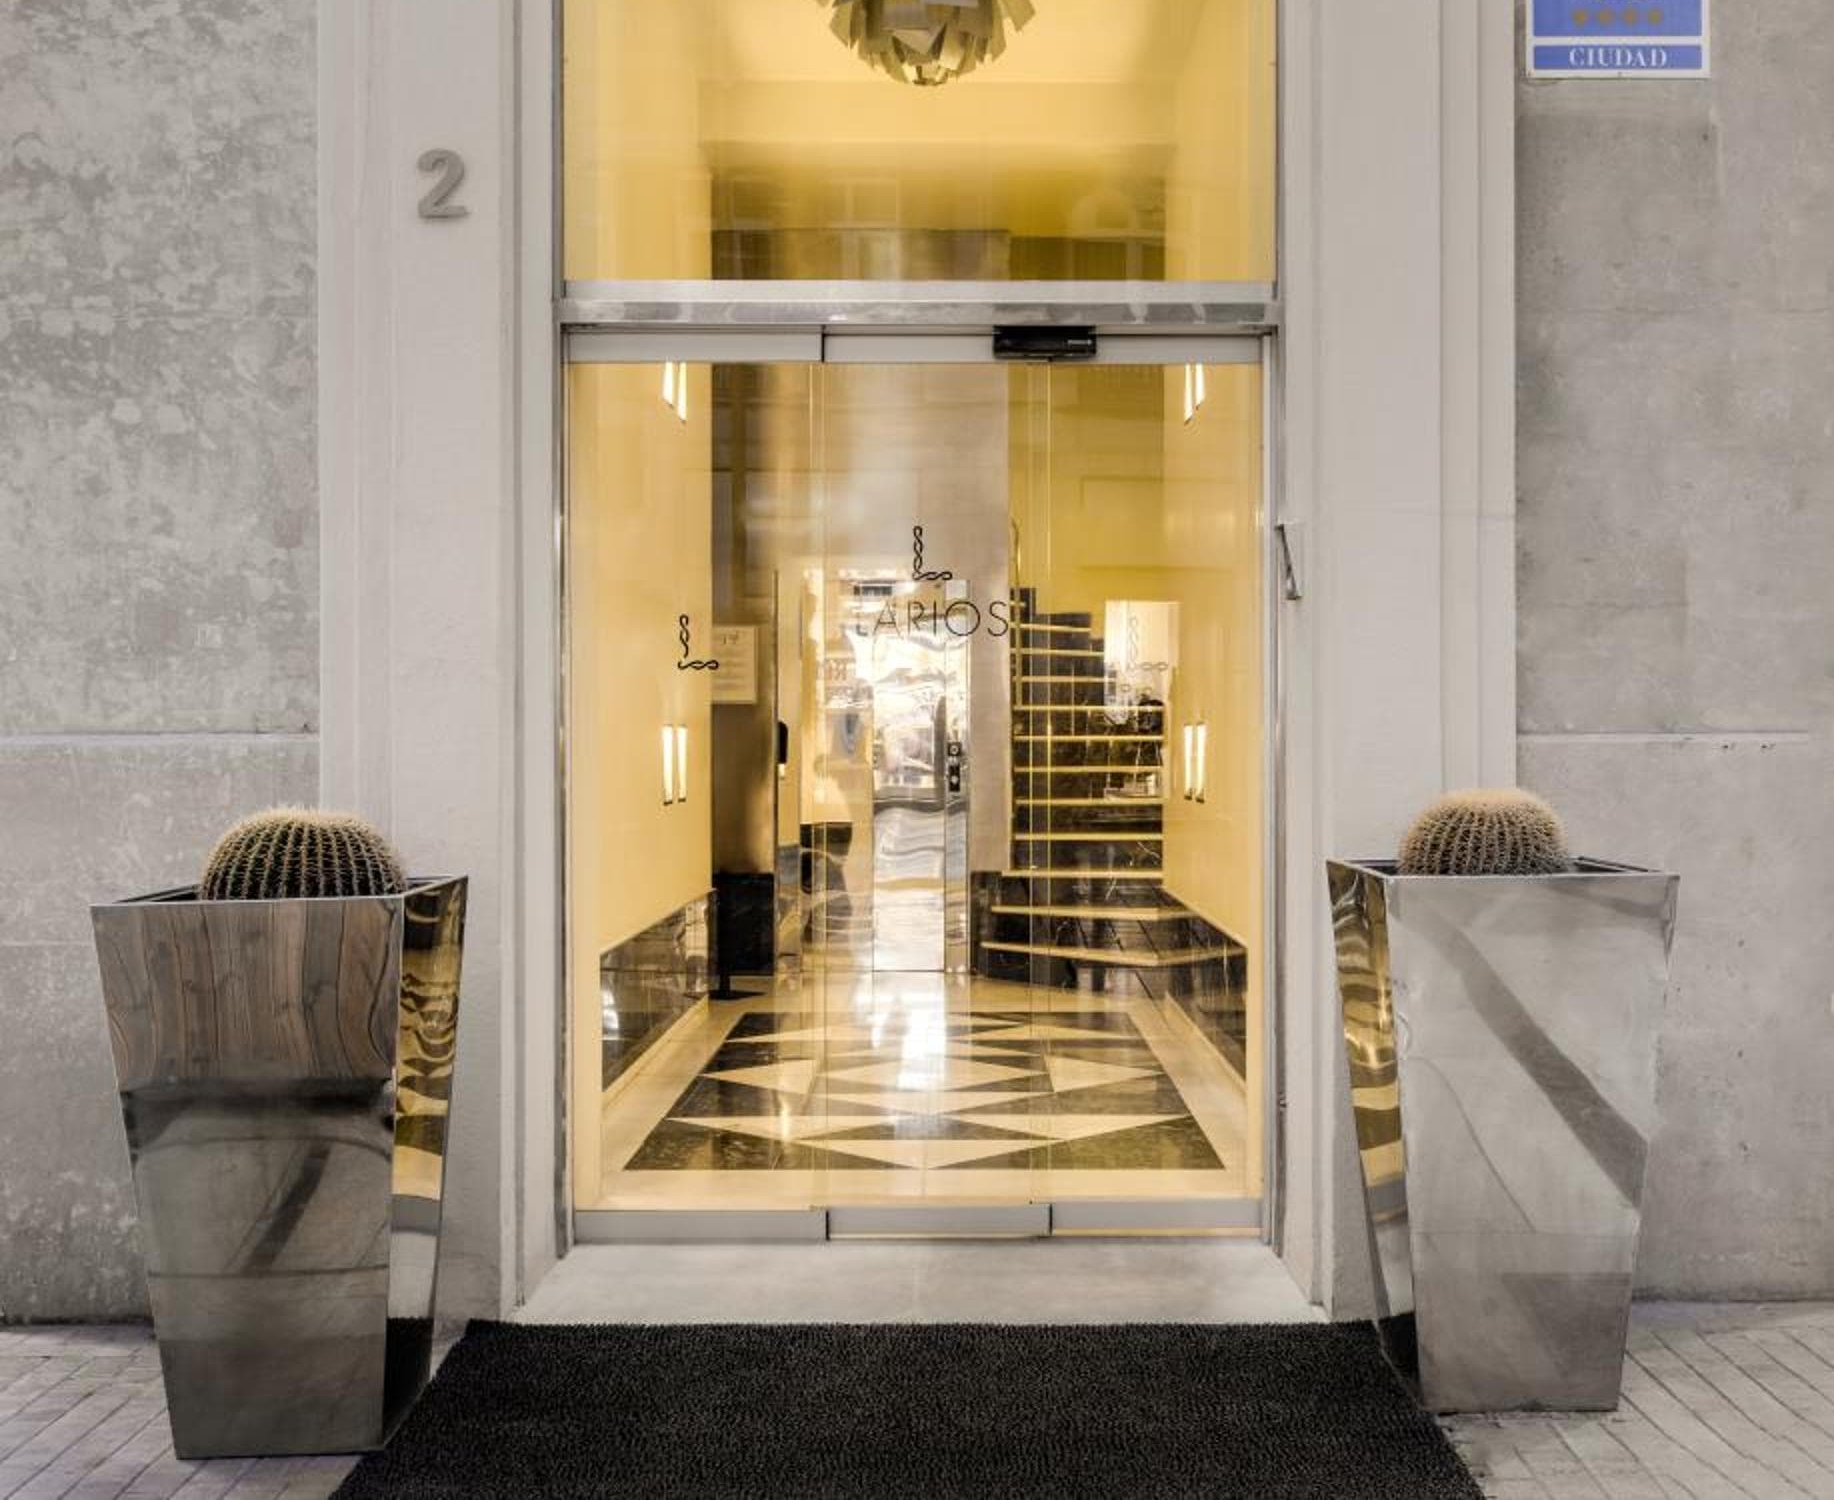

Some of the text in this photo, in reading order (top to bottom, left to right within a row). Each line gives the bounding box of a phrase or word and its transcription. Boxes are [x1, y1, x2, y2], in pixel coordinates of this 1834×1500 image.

[1569, 47, 1667, 68] CIUDAD
[417, 148, 470, 220] 2
[855, 600, 1009, 638] LARIOS
